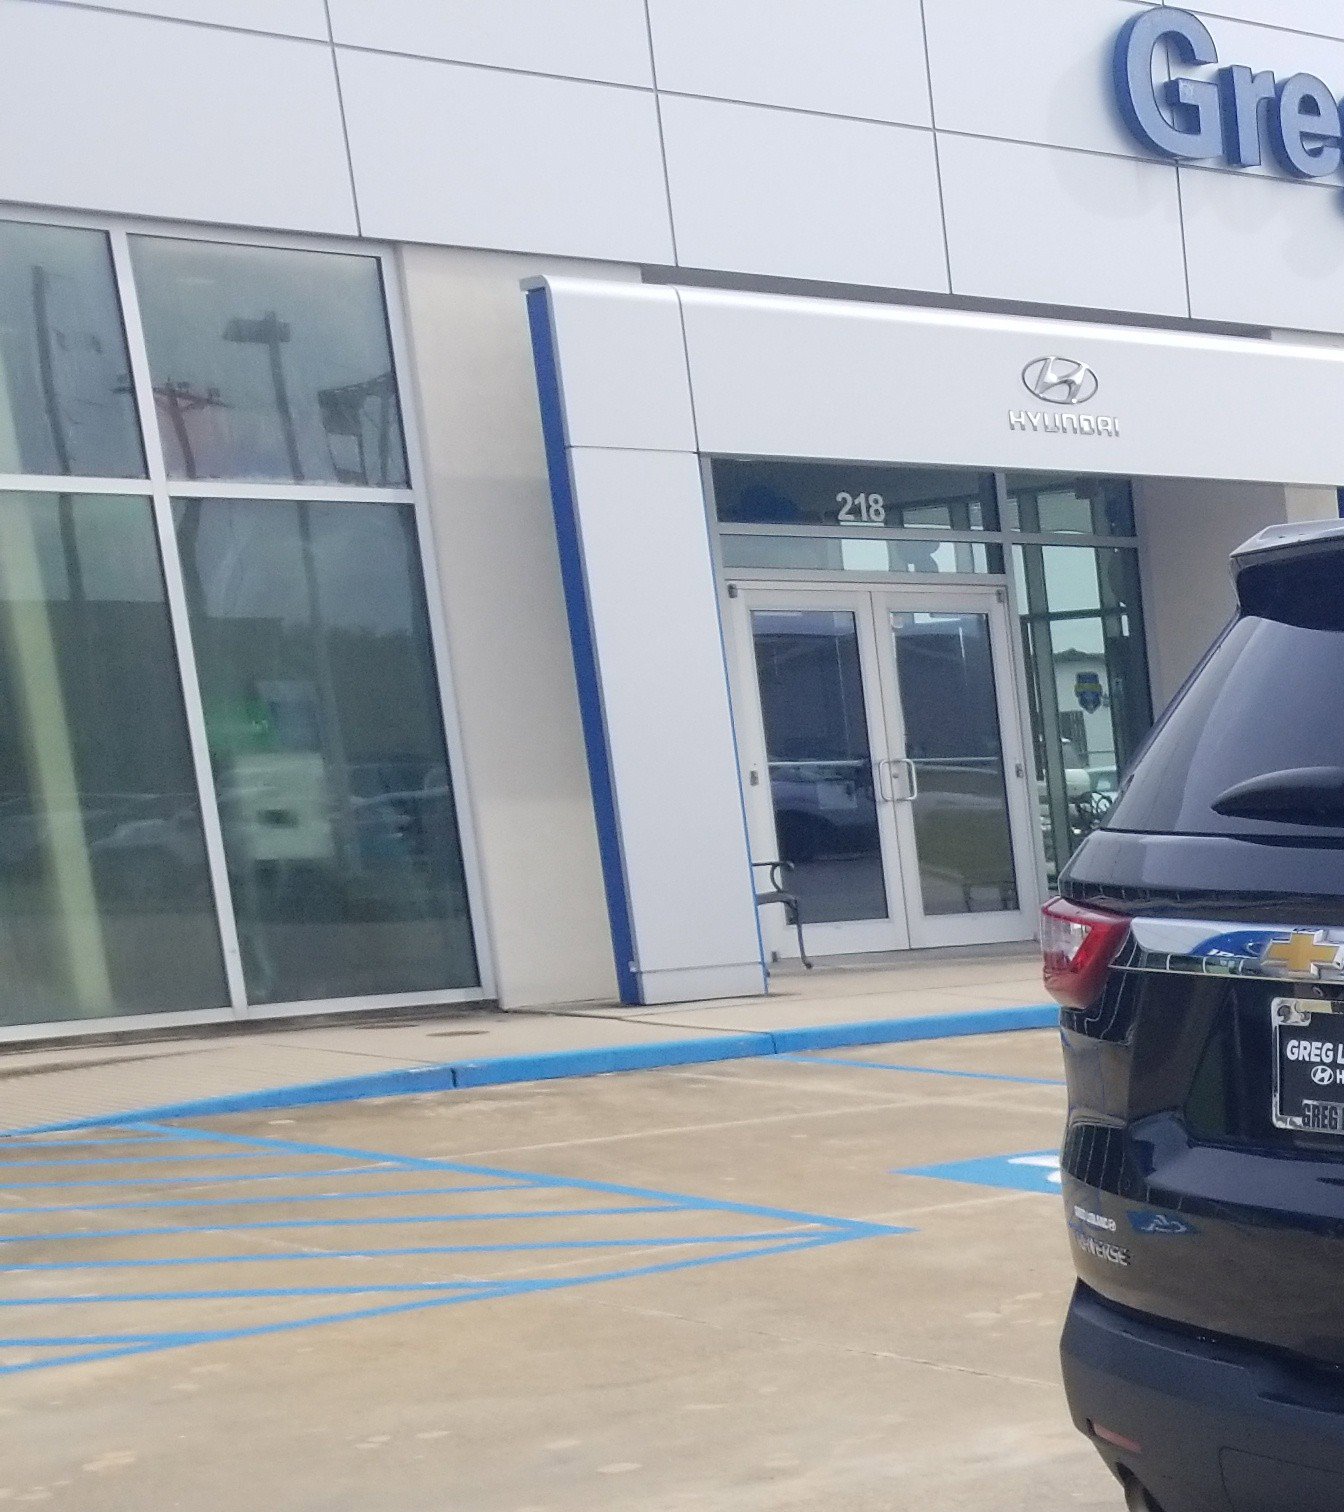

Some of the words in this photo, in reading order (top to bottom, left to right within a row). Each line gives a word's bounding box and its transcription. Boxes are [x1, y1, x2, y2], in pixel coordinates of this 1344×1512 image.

[1008, 409, 1120, 437] HYUNDAI
[835, 491, 886, 522] 218
[1286, 1039, 1334, 1064] GREG
[1302, 1102, 1338, 1130] GREG
